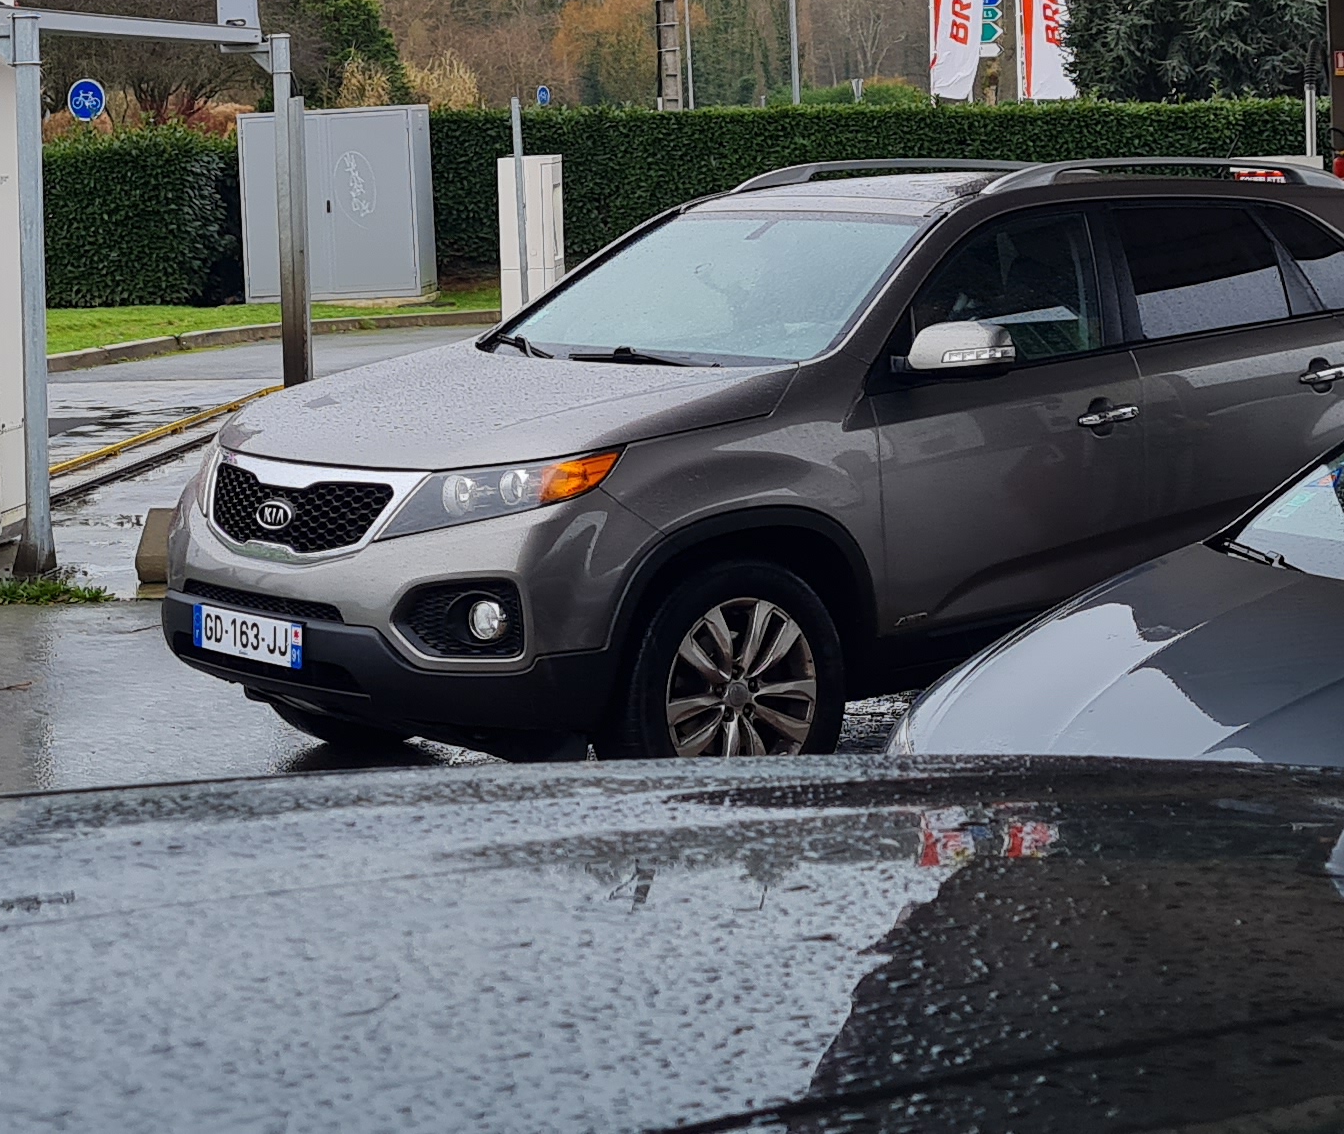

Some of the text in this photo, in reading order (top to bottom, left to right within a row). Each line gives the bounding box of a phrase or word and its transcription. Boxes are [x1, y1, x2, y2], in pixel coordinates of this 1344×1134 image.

[263, 506, 284, 524] KIA
[203, 612, 290, 657] GD-163-JJ
[291, 650, 301, 664] 91
